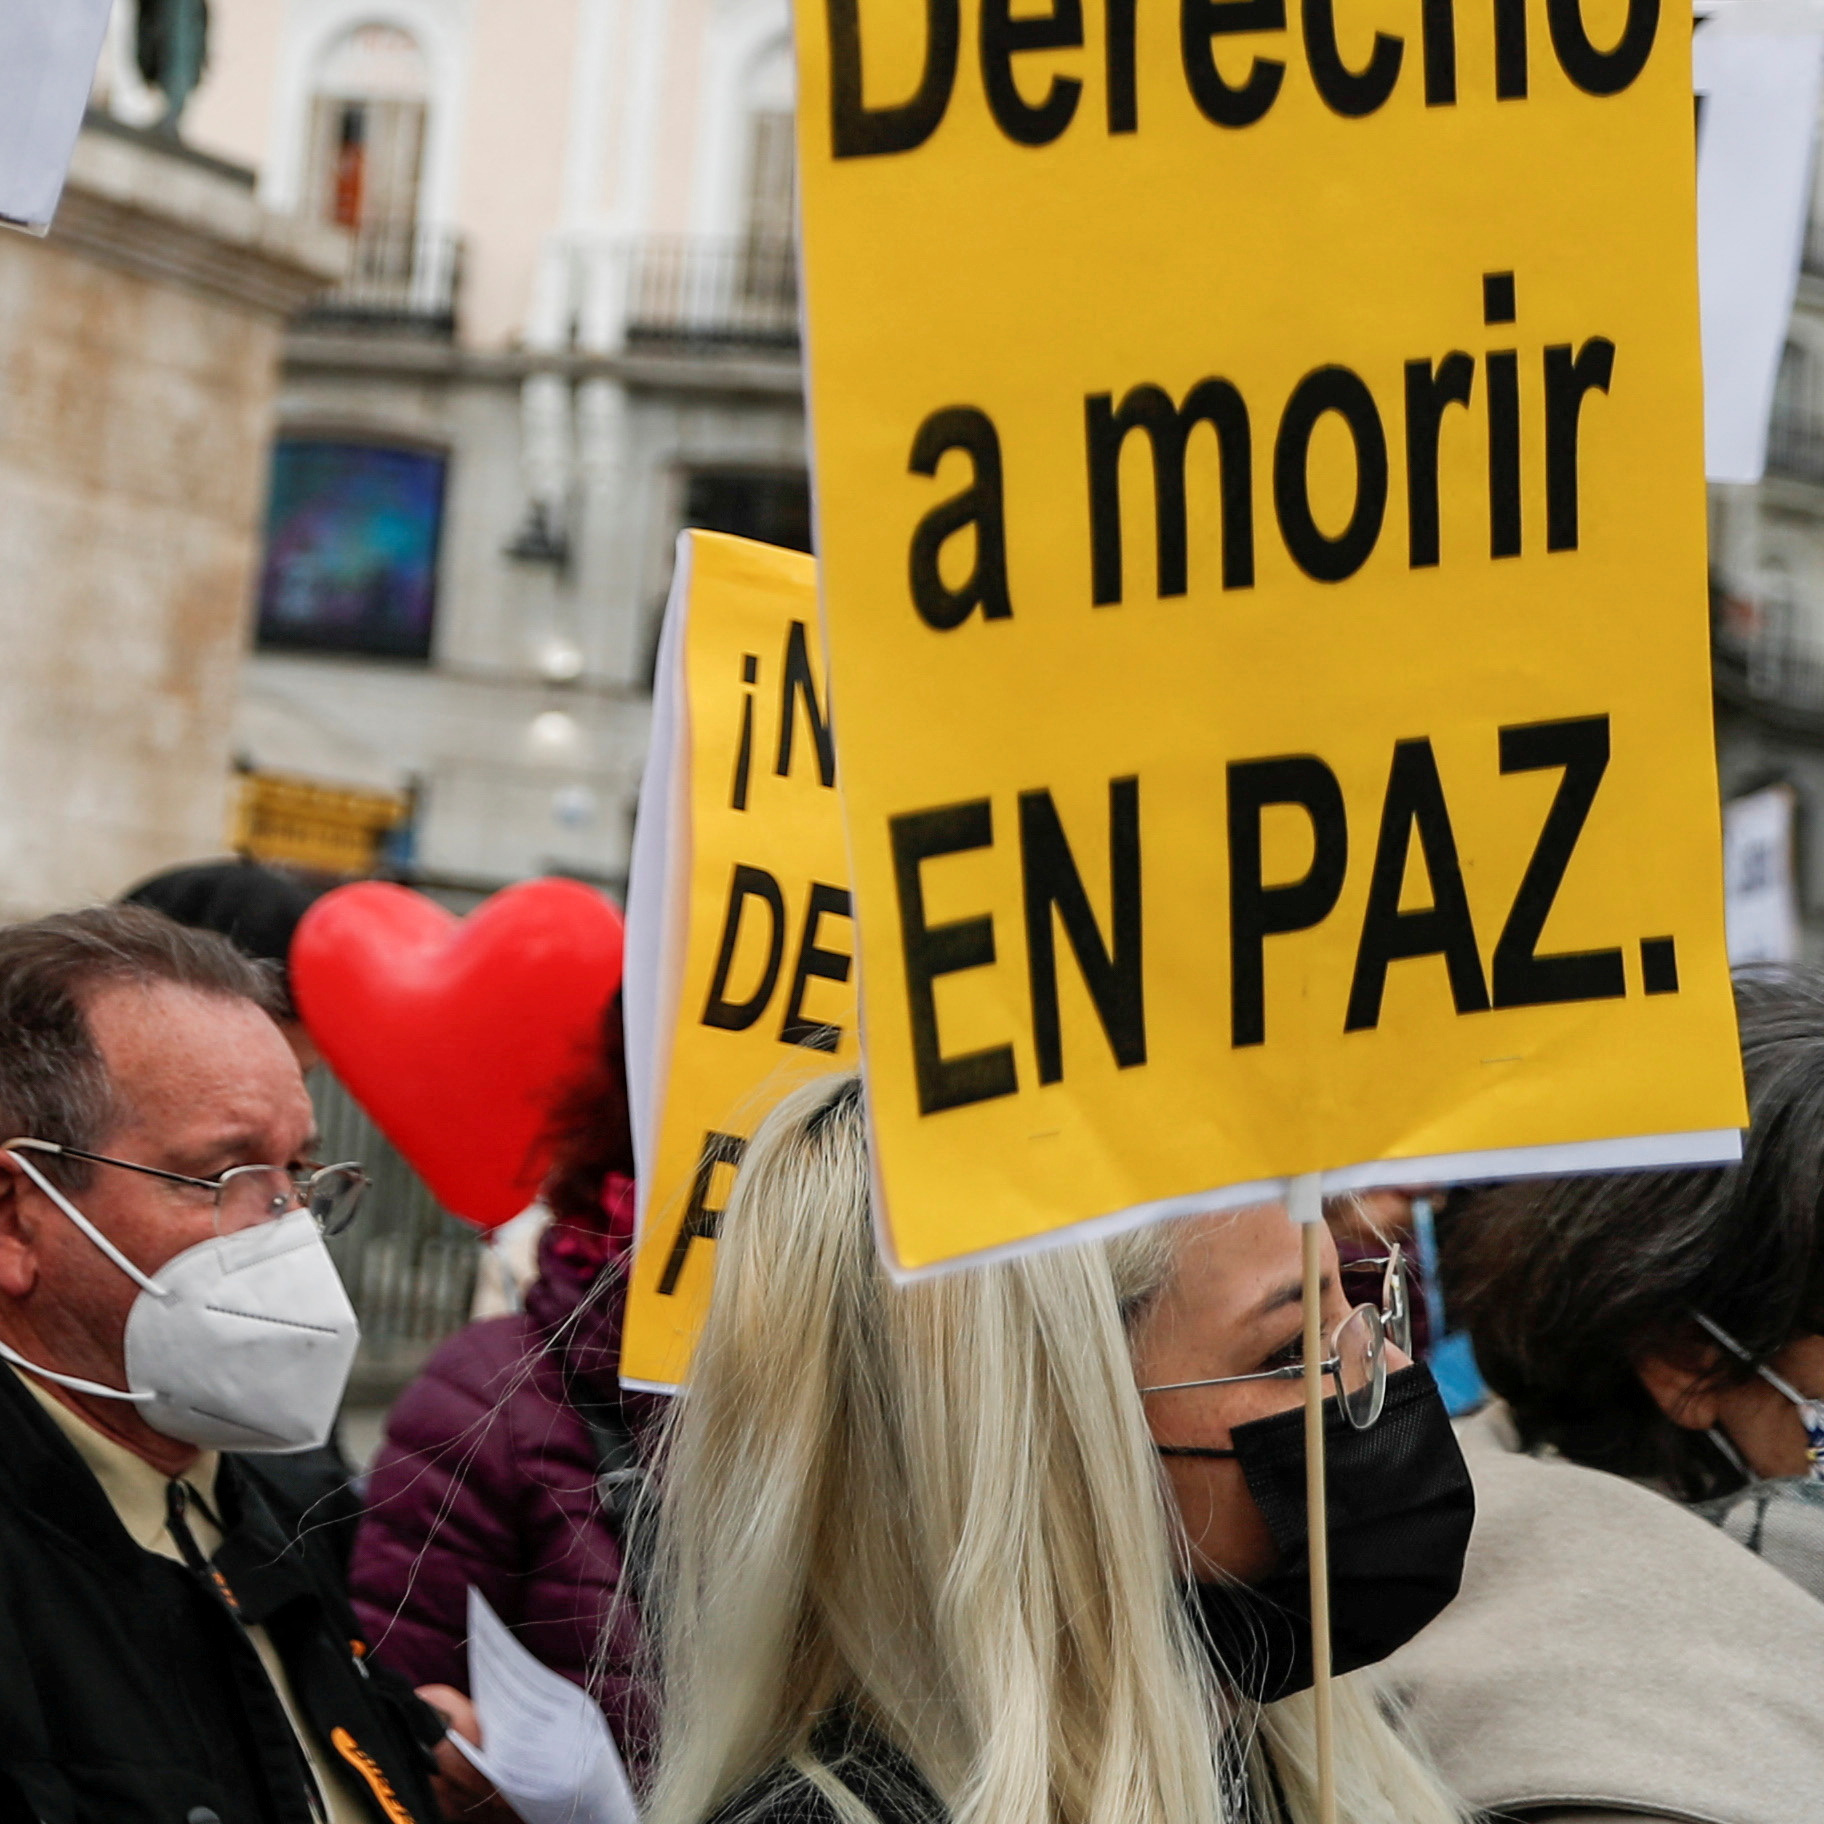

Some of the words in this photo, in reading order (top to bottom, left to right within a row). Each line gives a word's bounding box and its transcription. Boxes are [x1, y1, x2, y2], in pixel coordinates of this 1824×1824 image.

[906, 403, 1016, 635] a
[1082, 268, 1617, 610] morir
[886, 773, 1149, 1119] EN
[1224, 711, 1681, 1051] PAZ.
